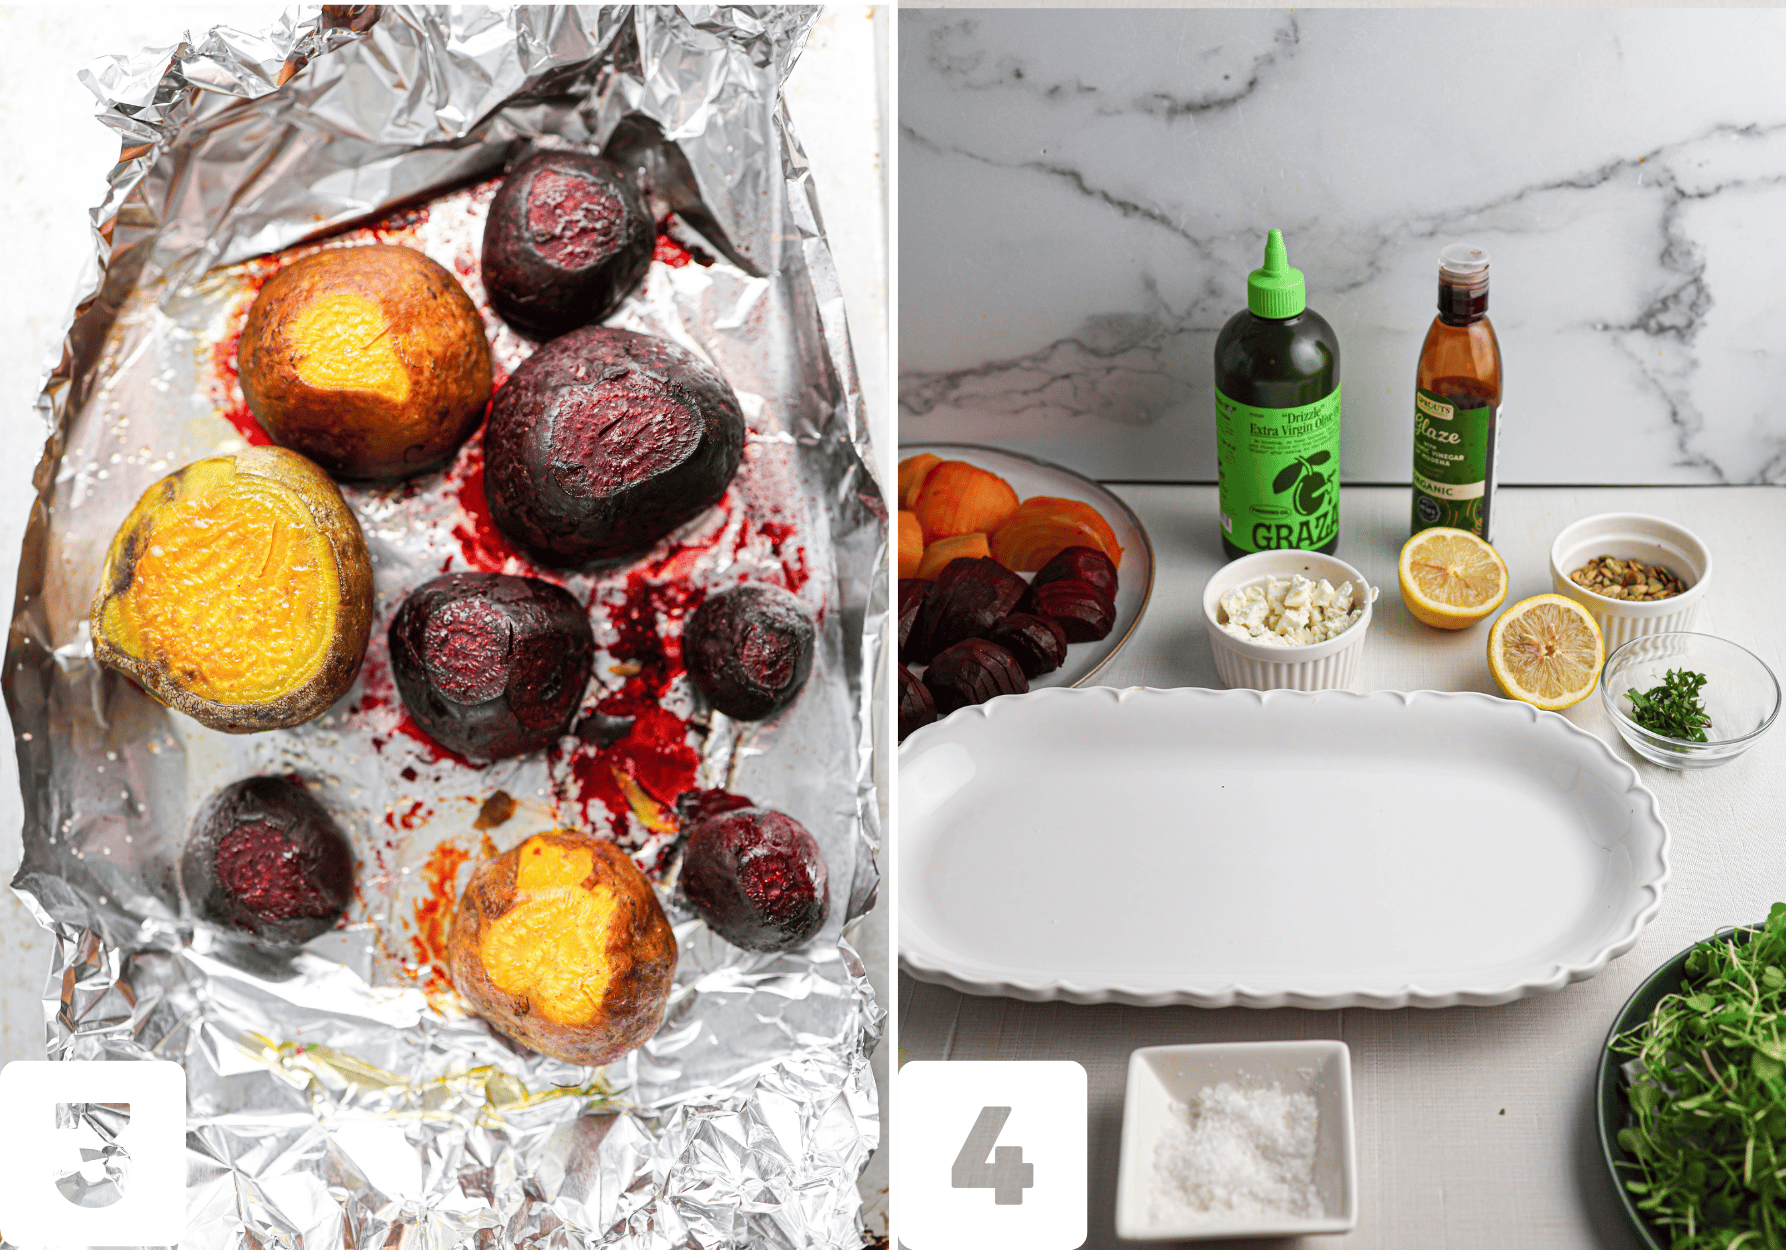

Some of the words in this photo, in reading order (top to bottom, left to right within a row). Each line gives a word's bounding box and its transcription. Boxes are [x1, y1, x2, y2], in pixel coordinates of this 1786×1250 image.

[1249, 422, 1279, 437] Extra
[1281, 421, 1313, 437] Virgin
[1431, 450, 1465, 462] VINEGAR
[1252, 501, 1339, 550] GRAZA
